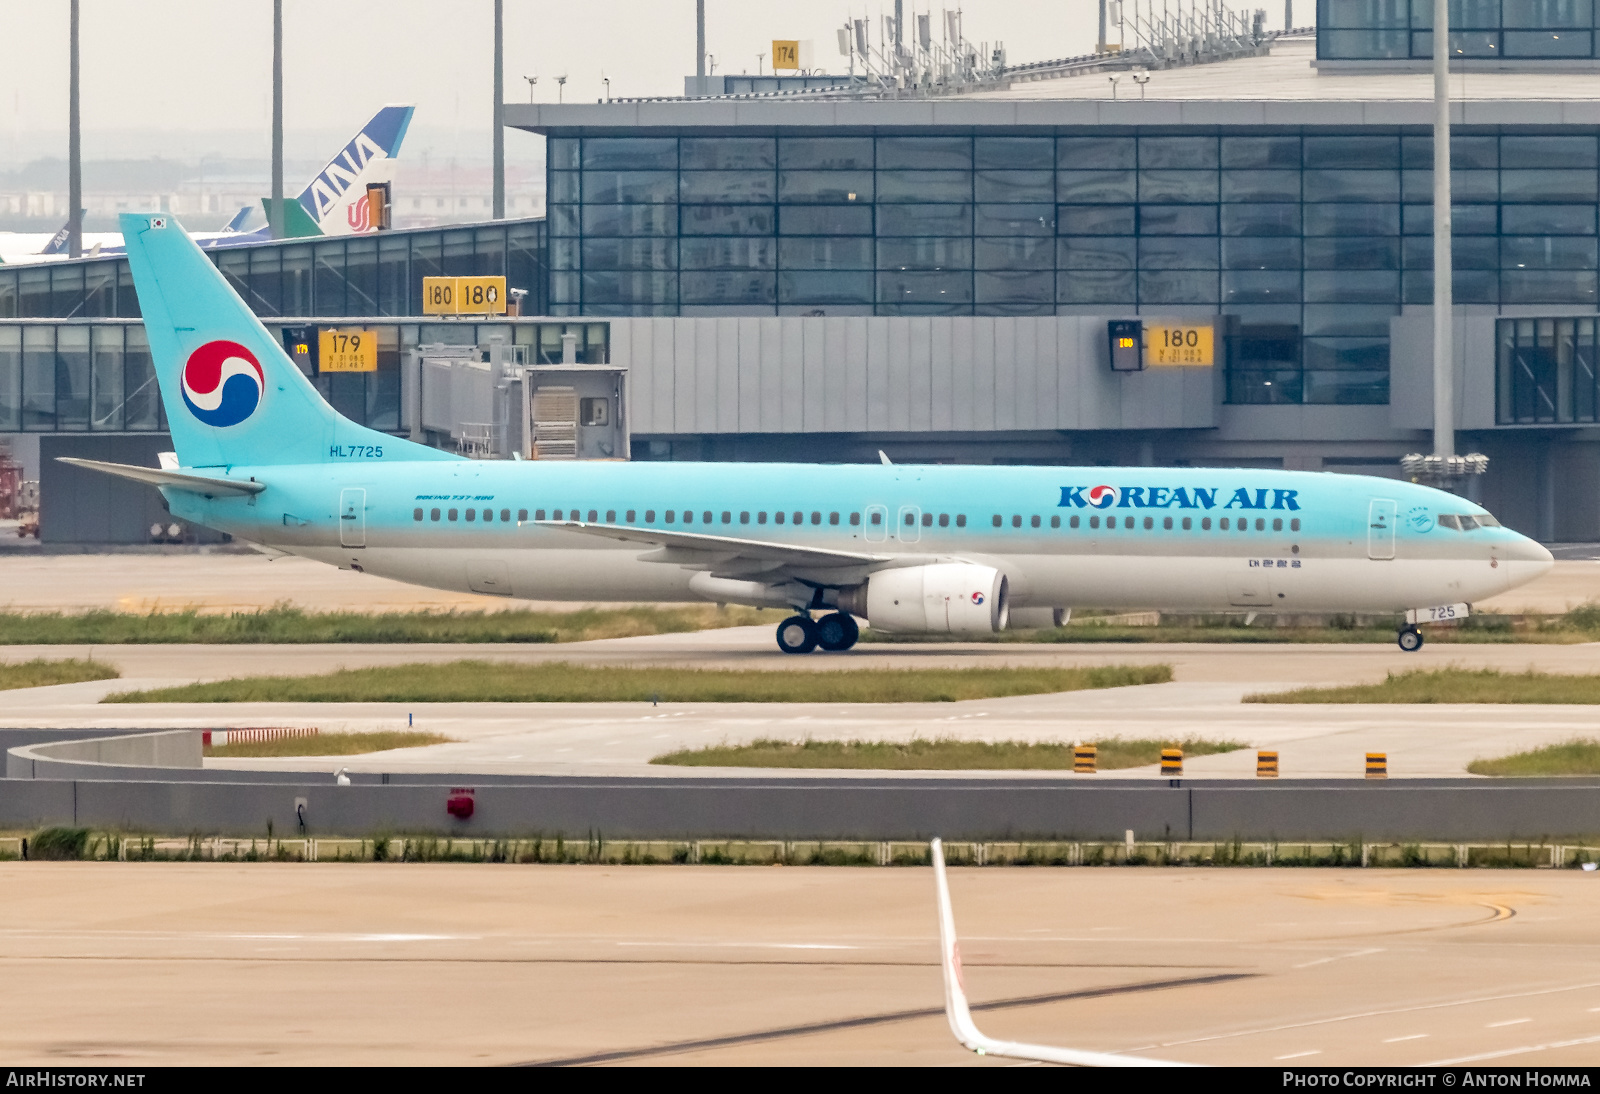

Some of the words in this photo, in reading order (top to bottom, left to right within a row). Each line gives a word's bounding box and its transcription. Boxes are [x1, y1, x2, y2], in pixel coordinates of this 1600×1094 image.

[777, 46, 795, 63] 174
[309, 131, 389, 224] ANA
[428, 285, 452, 306] 180
[465, 285, 498, 306] 180
[332, 335, 361, 353] 179
[1119, 338, 1134, 348] 180
[1163, 330, 1198, 347] 180
[296, 344, 308, 354] 179
[330, 445, 383, 458] HL7725
[1056, 485, 1219, 511] KOREAN
[1223, 487, 1302, 511] AIR
[1429, 605, 1455, 619] 725
